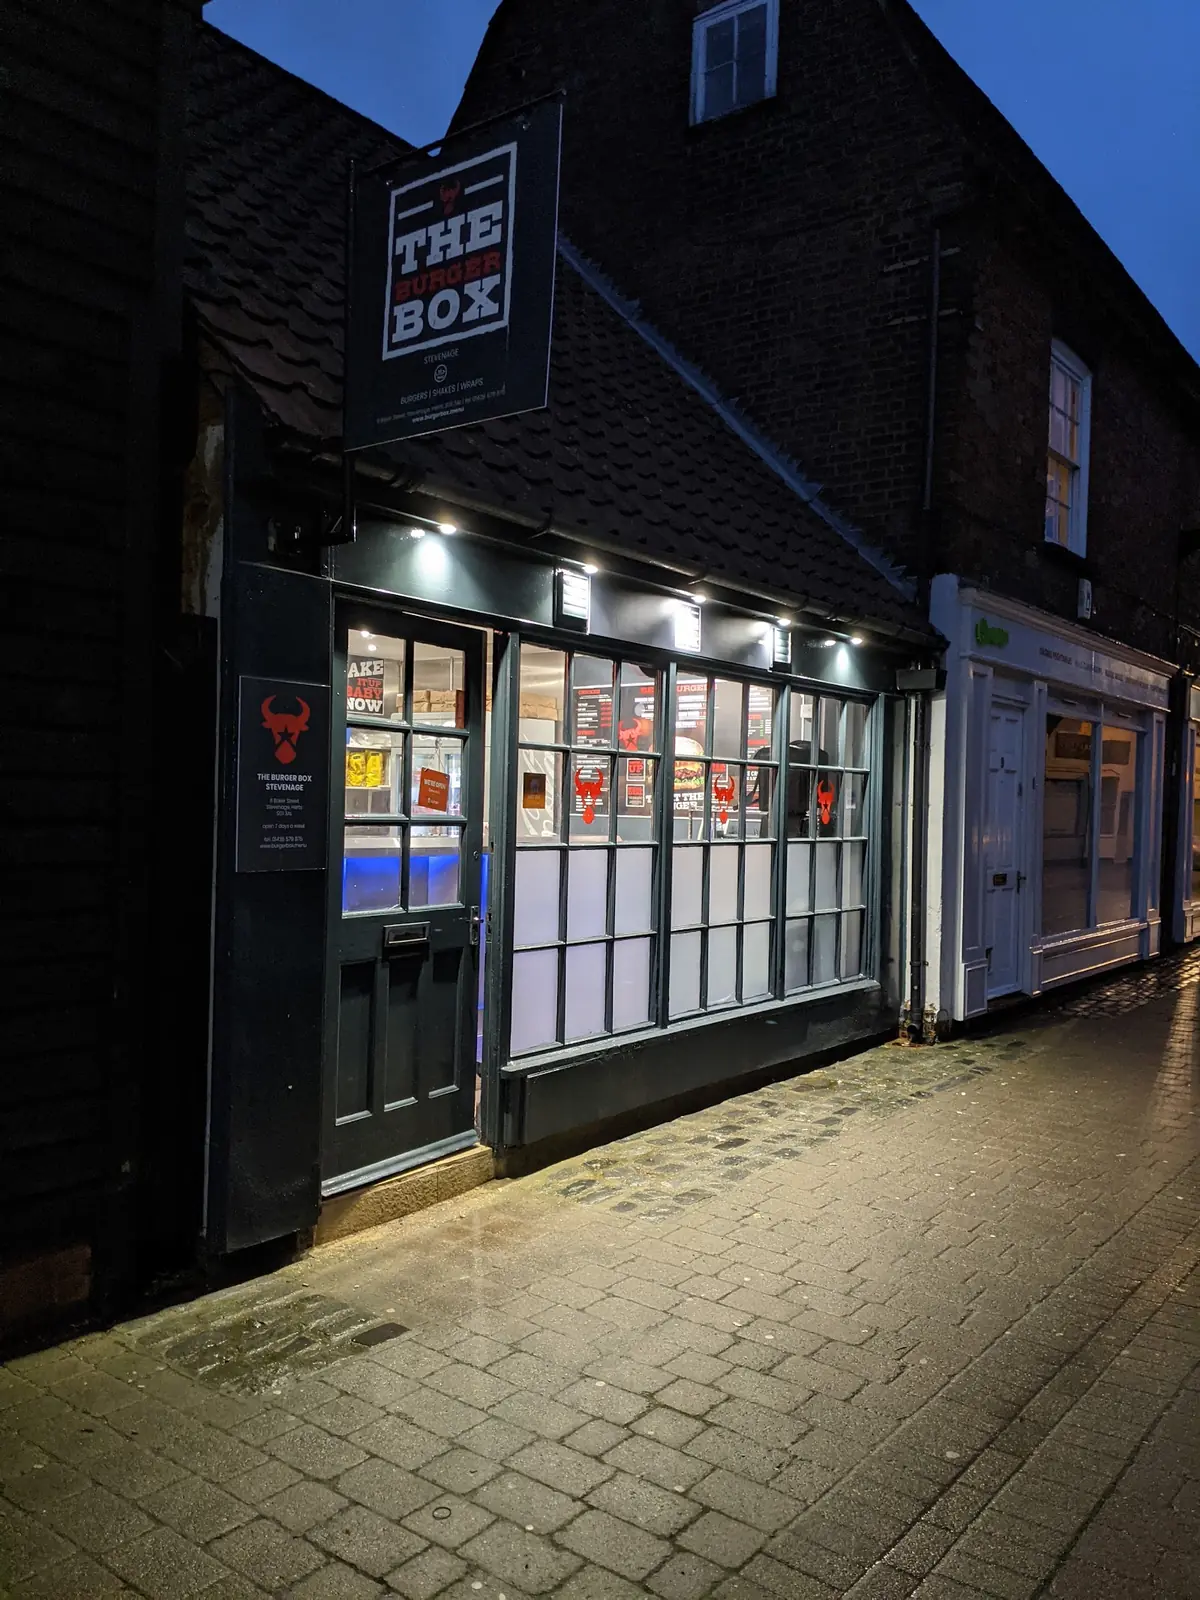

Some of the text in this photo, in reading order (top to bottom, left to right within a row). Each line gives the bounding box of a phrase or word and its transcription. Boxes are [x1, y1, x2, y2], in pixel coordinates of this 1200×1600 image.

[395, 200, 503, 274] THE
[394, 251, 500, 300] BURGER
[392, 274, 501, 343] BOX
[423, 348, 460, 364] STEVENAGE
[400, 377, 484, 405] BURGERS SHAKES WRAPS
[348, 660, 384, 678] AKE
[357, 678, 382, 687] IT UP
[347, 687, 383, 699] BABY
[347, 698, 383, 712] NOW
[257, 773, 270, 781] THE
[271, 774, 297, 782] BURGER
[265, 783, 304, 791] STEVENAGE
[682, 792, 705, 801] THE
